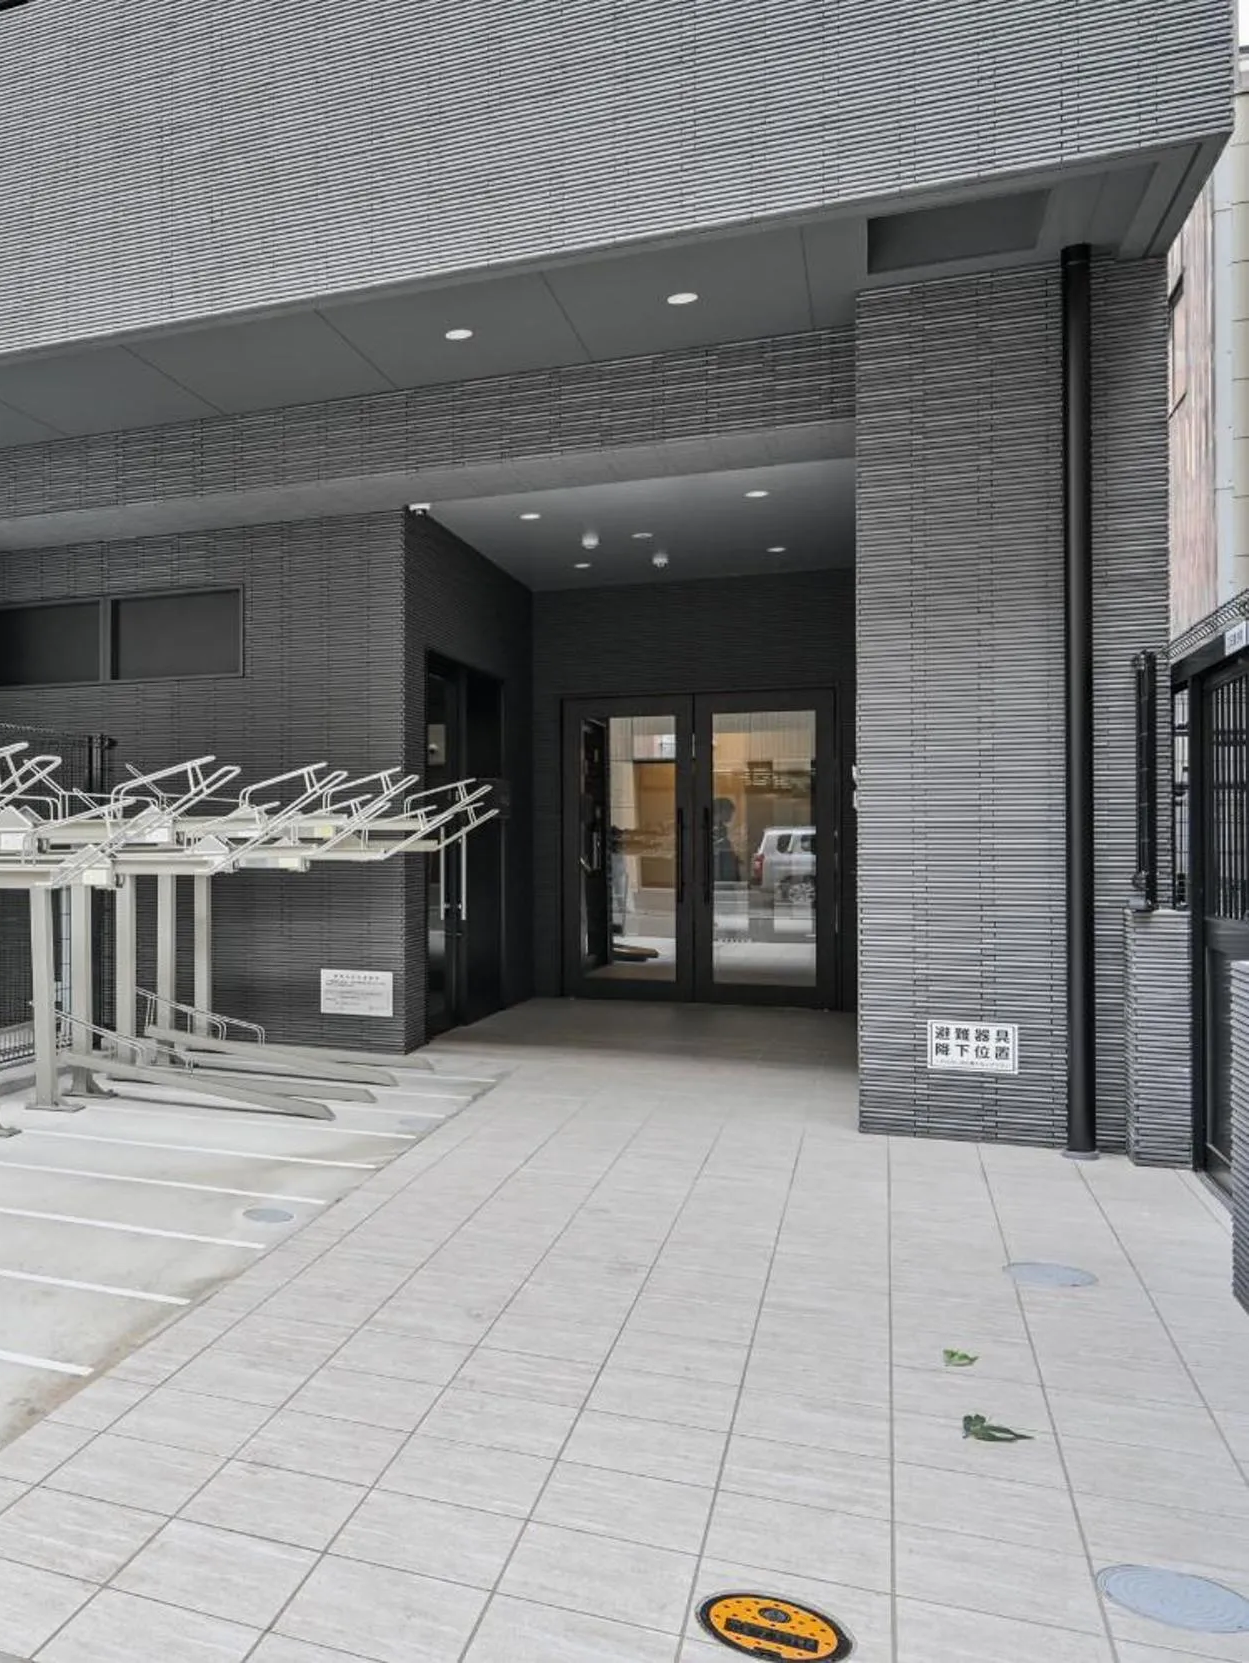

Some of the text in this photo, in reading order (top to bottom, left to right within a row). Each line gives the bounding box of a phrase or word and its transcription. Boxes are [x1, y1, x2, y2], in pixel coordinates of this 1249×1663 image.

[935, 1026, 1010, 1044] 避難器具
[935, 1042, 1010, 1061] 降下位置
